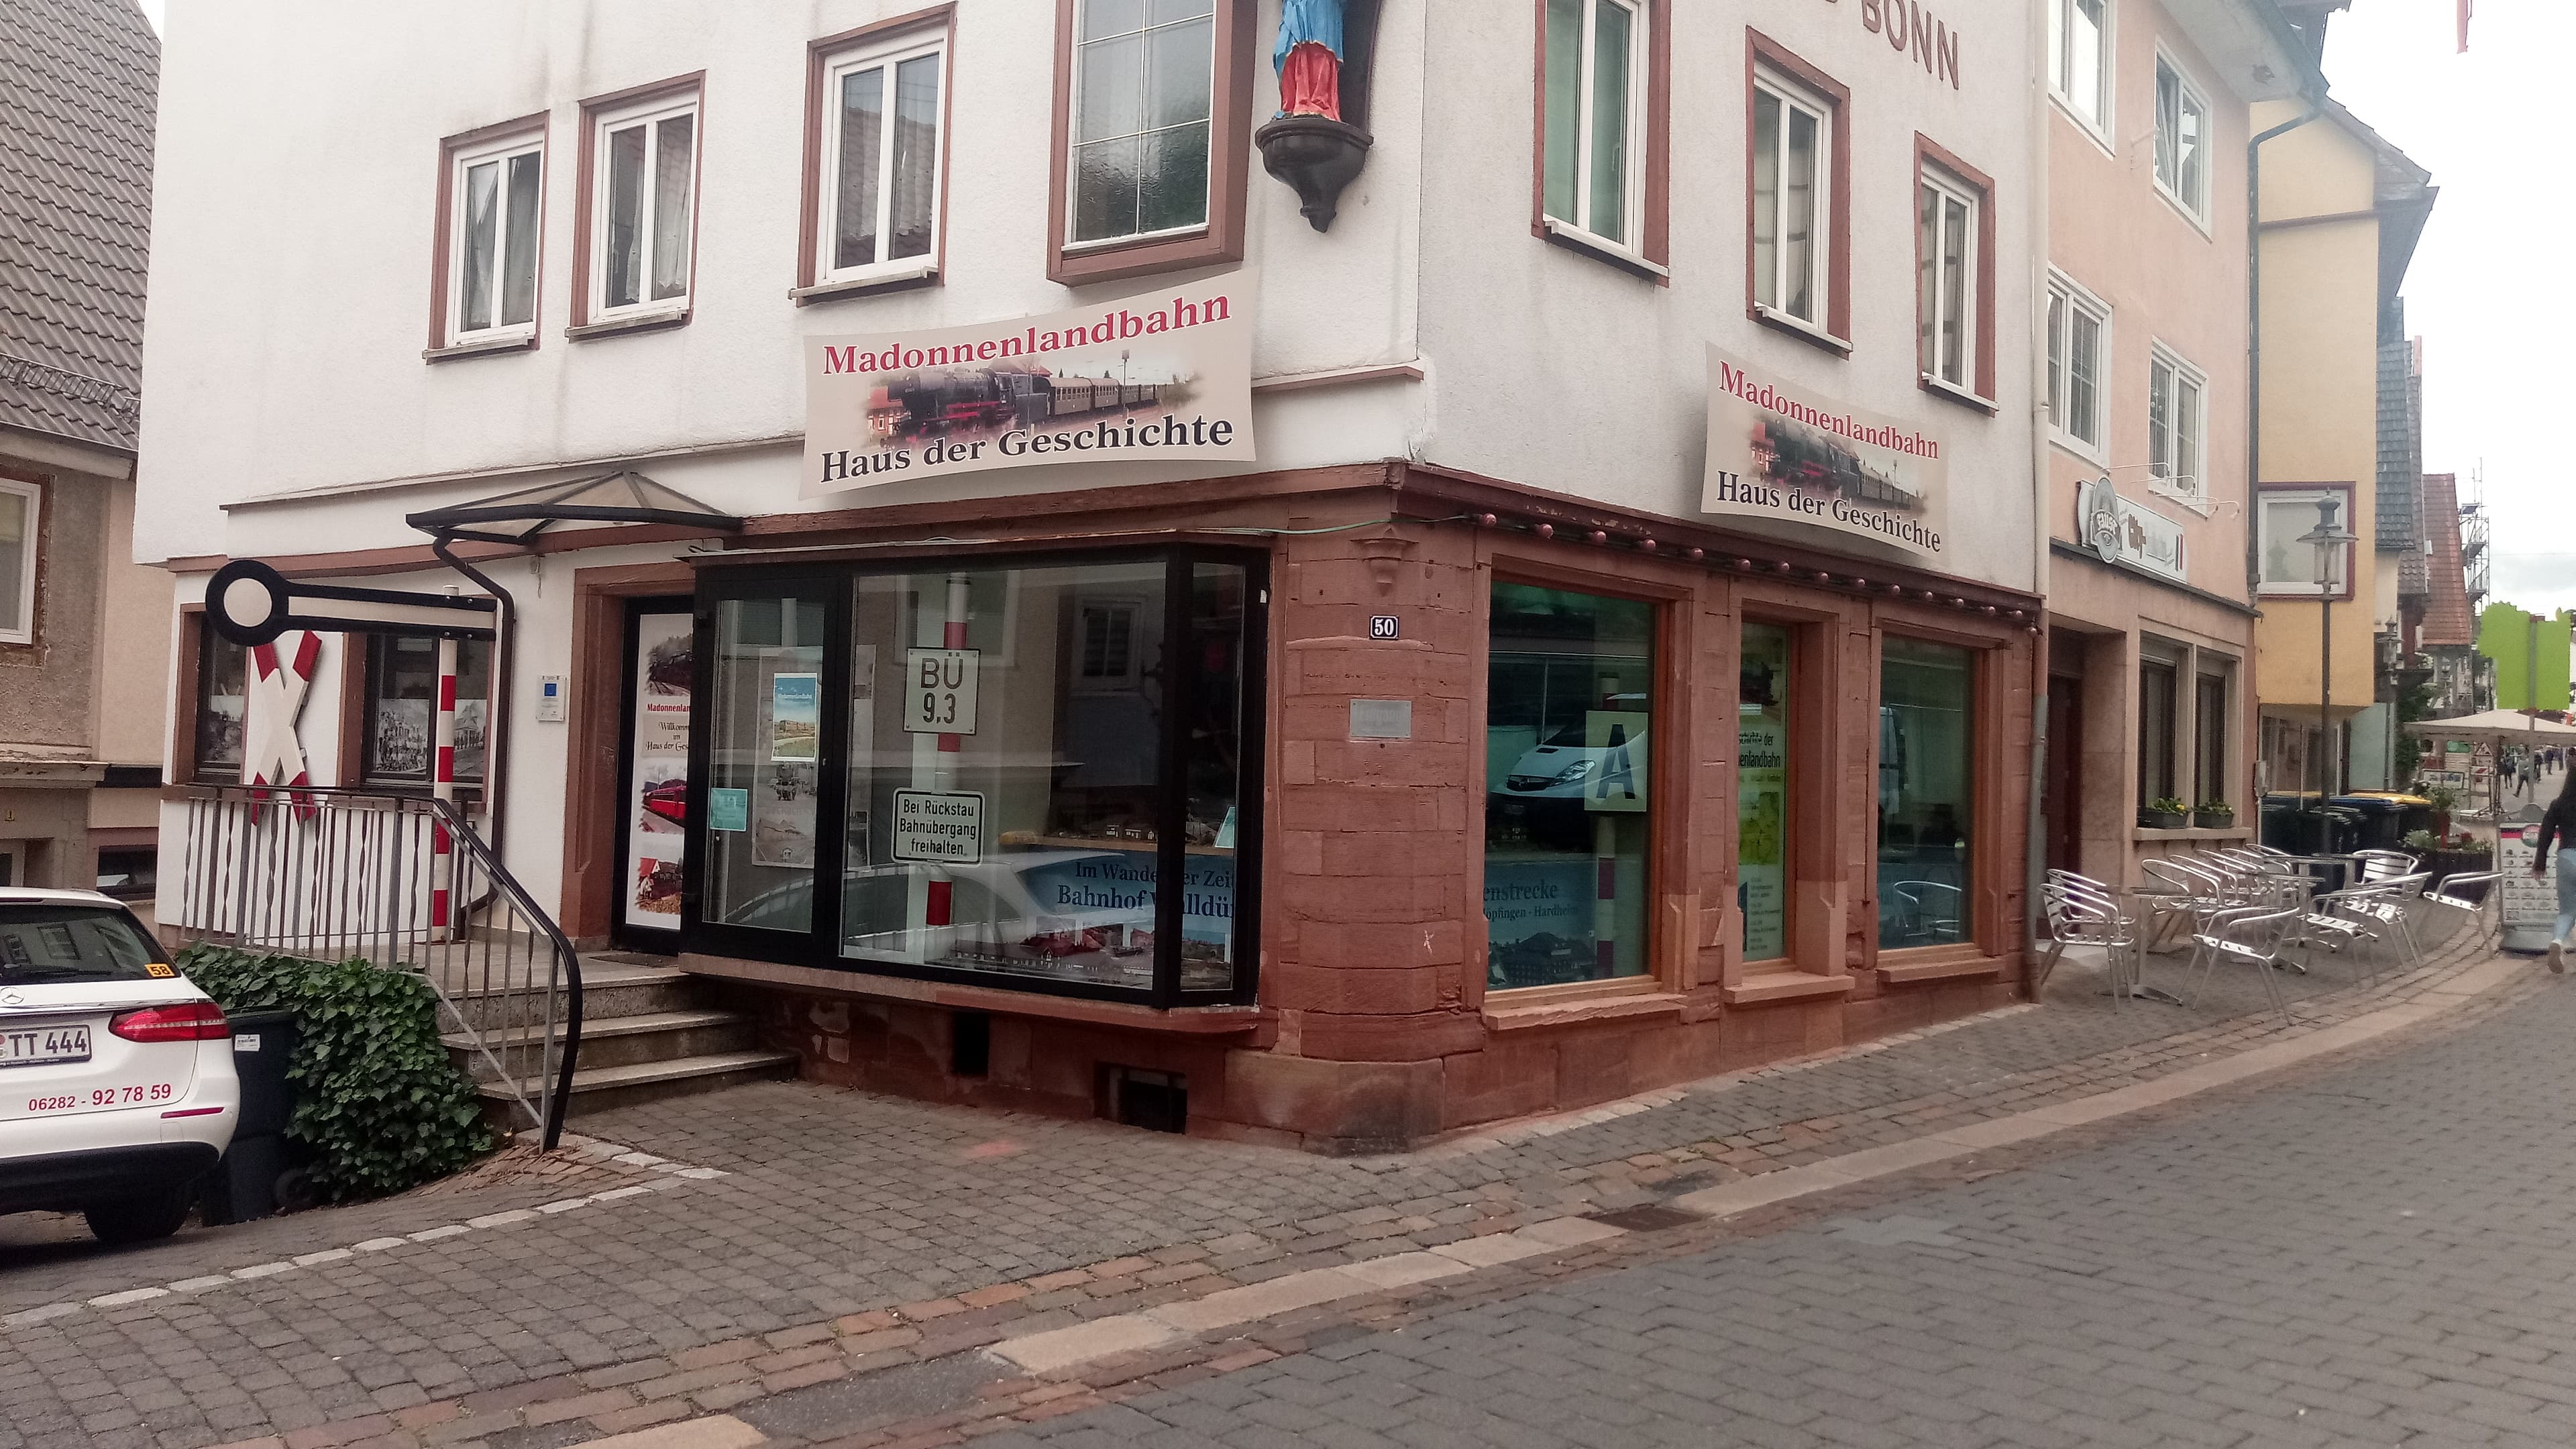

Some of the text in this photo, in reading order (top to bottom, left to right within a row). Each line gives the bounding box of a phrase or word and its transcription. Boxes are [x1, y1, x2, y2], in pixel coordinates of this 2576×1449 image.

[823, 295, 1230, 374] Madonnenlandbahn
[1719, 360, 1939, 459] Madonnenlandbahn
[820, 413, 1234, 484] Haus der Geschichte
[1717, 470, 1941, 552] Haus der Geschichte
[1374, 619, 1395, 636] 50
[921, 652, 963, 690] BÜ
[923, 692, 956, 724] 9,3
[646, 741, 663, 750] Haus
[664, 741, 674, 749] der
[1596, 724, 1636, 800] A
[1739, 750, 1780, 768] enlandbahn
[904, 799, 974, 816] Bei Rückstau
[900, 818, 976, 840] Bahnübergang
[911, 838, 963, 855] freihalten
[1075, 861, 1097, 878] Im
[1103, 863, 1156, 882] Wande
[1183, 872, 1199, 885] er
[1058, 884, 1147, 910] Bahnhof
[151, 965, 170, 976] 58
[9, 1030, 87, 1057] TT 444
[29, 1095, 76, 1111] 06282
[93, 1089, 115, 1106] 92
[122, 1086, 143, 1103] 78
[151, 1084, 171, 1100] 59
